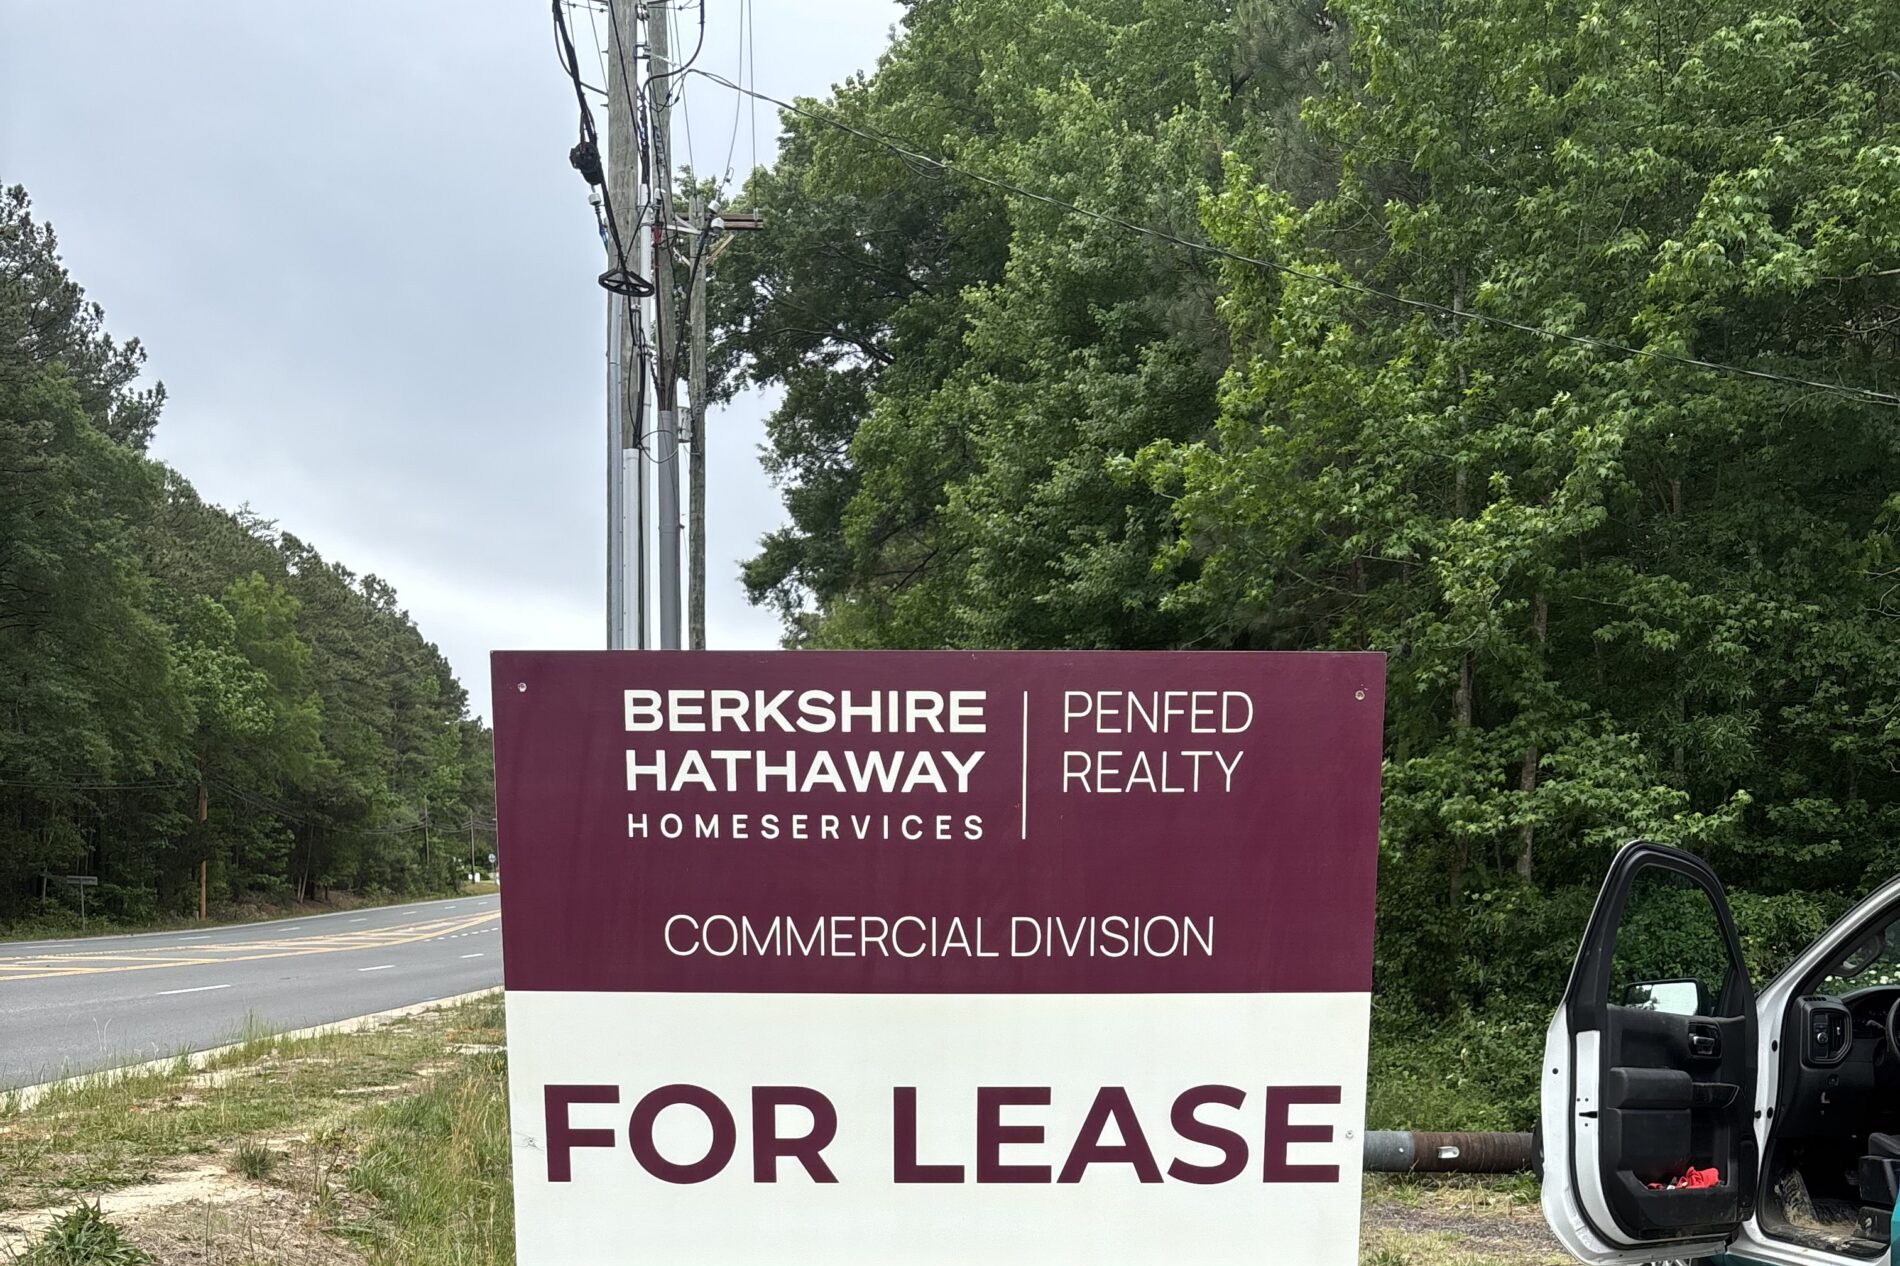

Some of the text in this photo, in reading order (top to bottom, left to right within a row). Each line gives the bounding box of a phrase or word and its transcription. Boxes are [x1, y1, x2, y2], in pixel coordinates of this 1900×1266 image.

[623, 689, 987, 734] BERKSHIRE
[1064, 690, 1254, 734] PENFED
[625, 749, 986, 793] HATHAWAY
[1063, 750, 1244, 793] REALTY
[627, 813, 983, 841] HOMESERVICES
[664, 914, 1214, 958] COMMERCIAL DIVISION
[543, 1083, 1342, 1185] FOR LEASE
